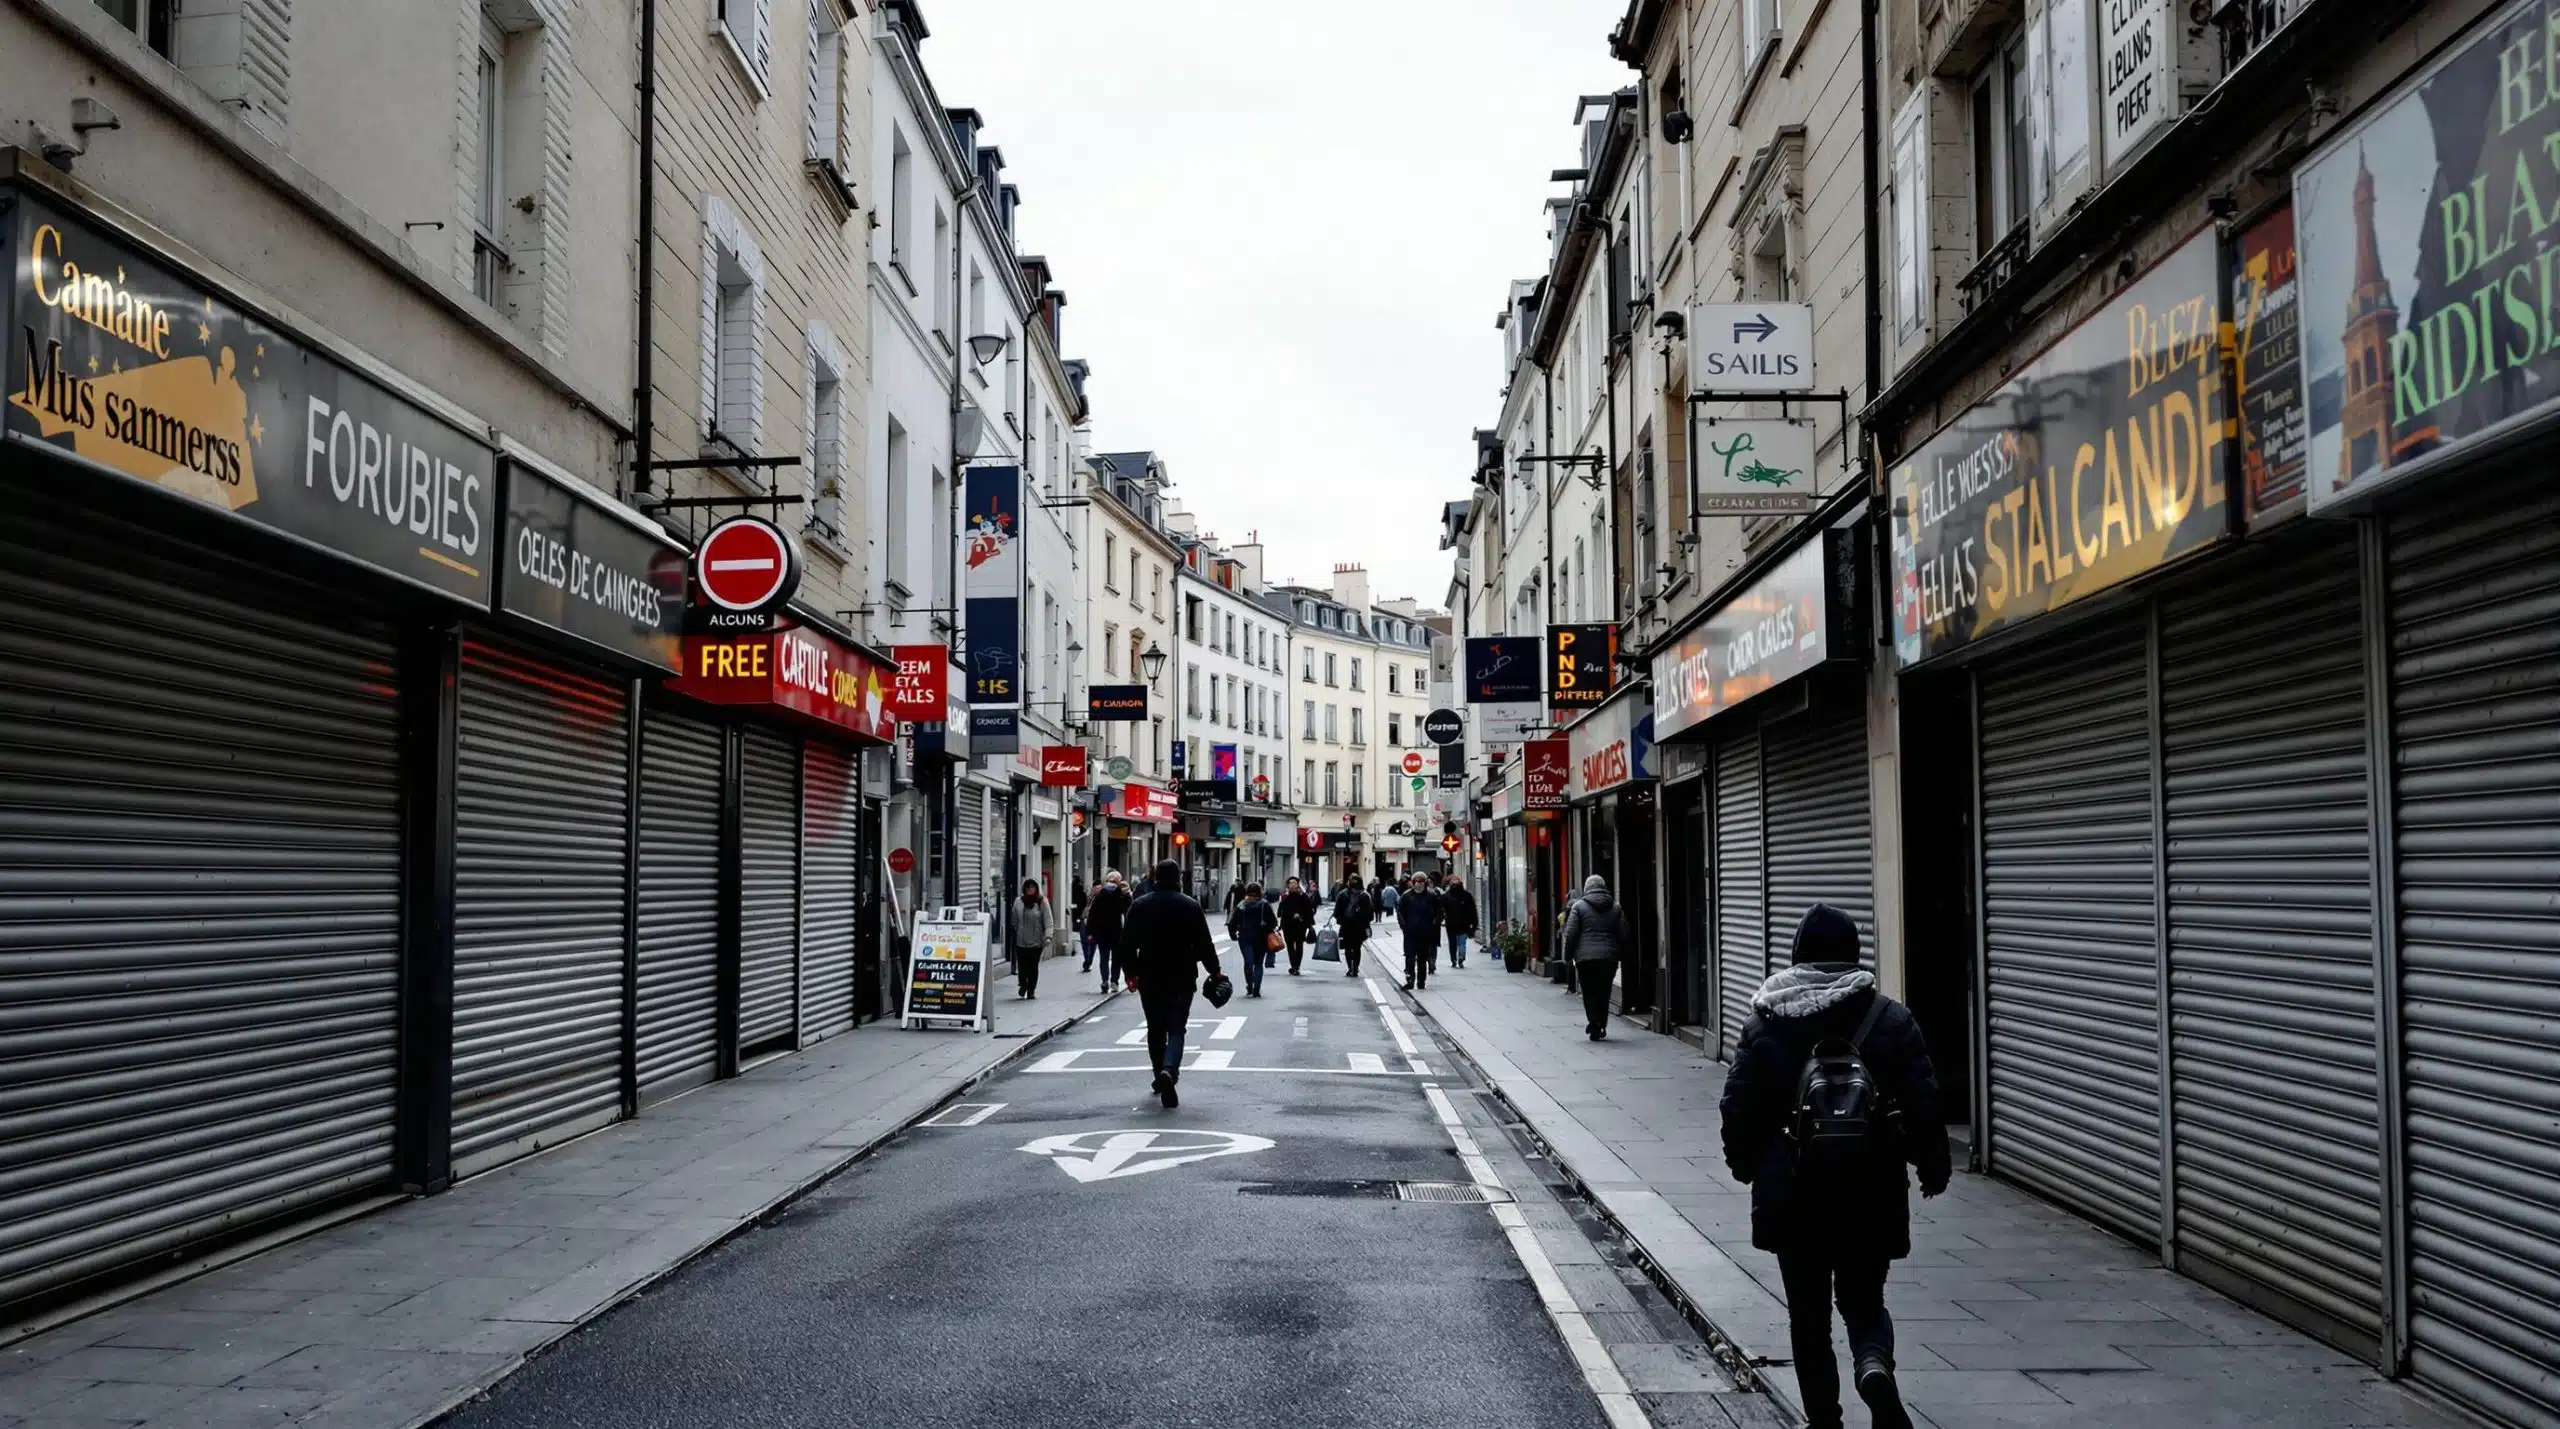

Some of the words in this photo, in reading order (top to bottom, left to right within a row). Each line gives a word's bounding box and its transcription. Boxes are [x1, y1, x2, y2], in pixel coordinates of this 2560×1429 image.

[22, 324, 95, 430] Mus
[1707, 352, 1799, 376] SAILIS
[305, 394, 480, 557] FORUBIES
[1984, 374, 2227, 612] STALCANDE
[518, 526, 566, 590] OELES
[570, 549, 591, 601] DE
[709, 614, 765, 626] ALCUNS
[701, 644, 768, 678] FREE
[895, 689, 935, 703] ALES
